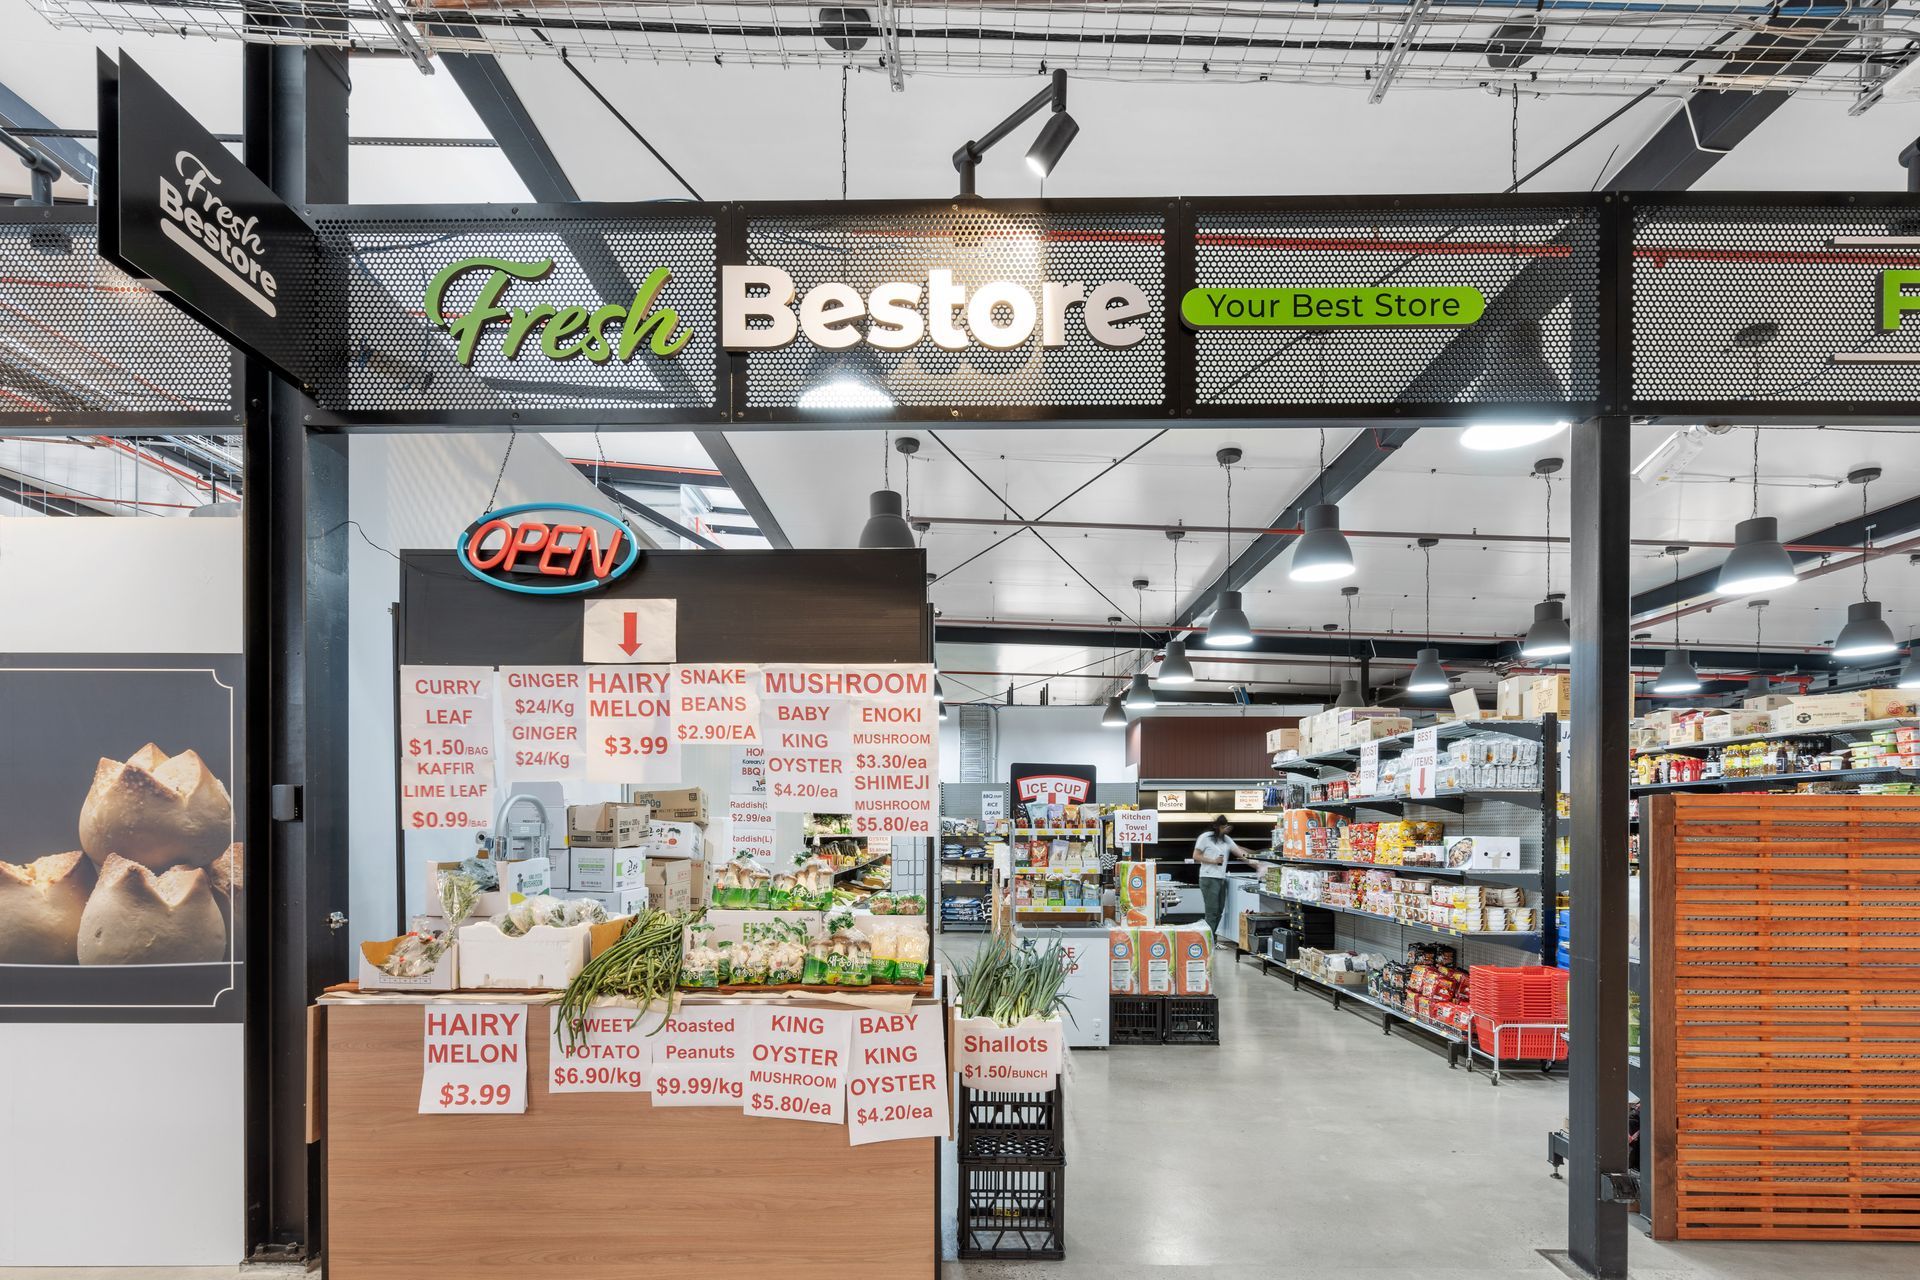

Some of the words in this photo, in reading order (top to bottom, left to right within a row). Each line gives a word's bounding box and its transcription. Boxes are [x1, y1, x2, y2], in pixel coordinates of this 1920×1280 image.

[175, 151, 265, 255] Fresh
[160, 176, 277, 297] Bestore
[424, 257, 693, 366] Fresh
[722, 265, 1151, 350] Bestore
[1207, 294, 1280, 318] Your
[1293, 294, 1364, 318] Best
[1375, 293, 1460, 318] Store
[468, 521, 623, 578] OPEN
[508, 672, 578, 688] GINGER
[588, 672, 670, 695] HAIRY
[680, 667, 747, 685] SNAKE
[765, 672, 928, 695] MUSHROOM
[415, 678, 480, 695] CURRY
[515, 699, 574, 717] $24/Kg
[588, 699, 671, 719] MELON
[681, 694, 748, 713] BEANS
[426, 708, 472, 725] LEAF
[777, 705, 830, 721] BABY
[860, 705, 921, 724] ENOKI
[512, 726, 576, 740] GINGER
[676, 722, 757, 741] $2.90/EA
[852, 732, 931, 746] MUSHROOM
[1417, 730, 1433, 743] BEST
[408, 737, 488, 757] $1.50/BAG
[604, 735, 669, 756] $3.99
[782, 733, 828, 749] KING
[517, 751, 569, 768] $24/Kg
[1361, 745, 1377, 757] MOST
[417, 761, 474, 777] KAFFIR
[769, 757, 842, 774] OYSTER
[855, 753, 928, 769] $3.30/ea
[1413, 756, 1434, 768] ITEMS
[854, 774, 929, 791] SHIMEJI
[1362, 769, 1376, 779] ITEMS
[403, 785, 445, 799] LIME
[450, 784, 485, 799] LEAF
[775, 784, 837, 798] $4.20/ea
[1026, 782, 1048, 794] ICE
[1054, 782, 1082, 795] CUP
[855, 800, 930, 812] MUSHROOM
[411, 809, 487, 828] $0.99/BAG
[732, 814, 771, 823] $2.99/ea
[857, 816, 928, 832] $5.80/ea
[1121, 813, 1151, 821] Kitchen
[1118, 832, 1152, 842] $12.14
[427, 1012, 519, 1037] HAIRY
[573, 1018, 633, 1033] SWEET
[664, 1018, 735, 1033] Roasted
[771, 1014, 825, 1036] KING
[859, 1013, 918, 1035] BABY
[428, 1042, 518, 1064] MELON
[566, 1045, 640, 1059] POTATO
[666, 1044, 736, 1061] Peanuts
[962, 1034, 1049, 1055] Shallots
[752, 1044, 838, 1067] OYSTER
[864, 1045, 918, 1065] KING
[554, 1066, 641, 1088] $6.90/kg
[749, 1070, 837, 1089] MUSHROOM
[963, 1063, 1048, 1081] $1.50/BUNCH
[656, 1077, 743, 1100] $9.99/kg
[849, 1073, 937, 1096] OYSTER
[439, 1083, 511, 1108] $3.99
[749, 1093, 832, 1117] $5.80/ea
[857, 1104, 933, 1126] $4.20/ea
